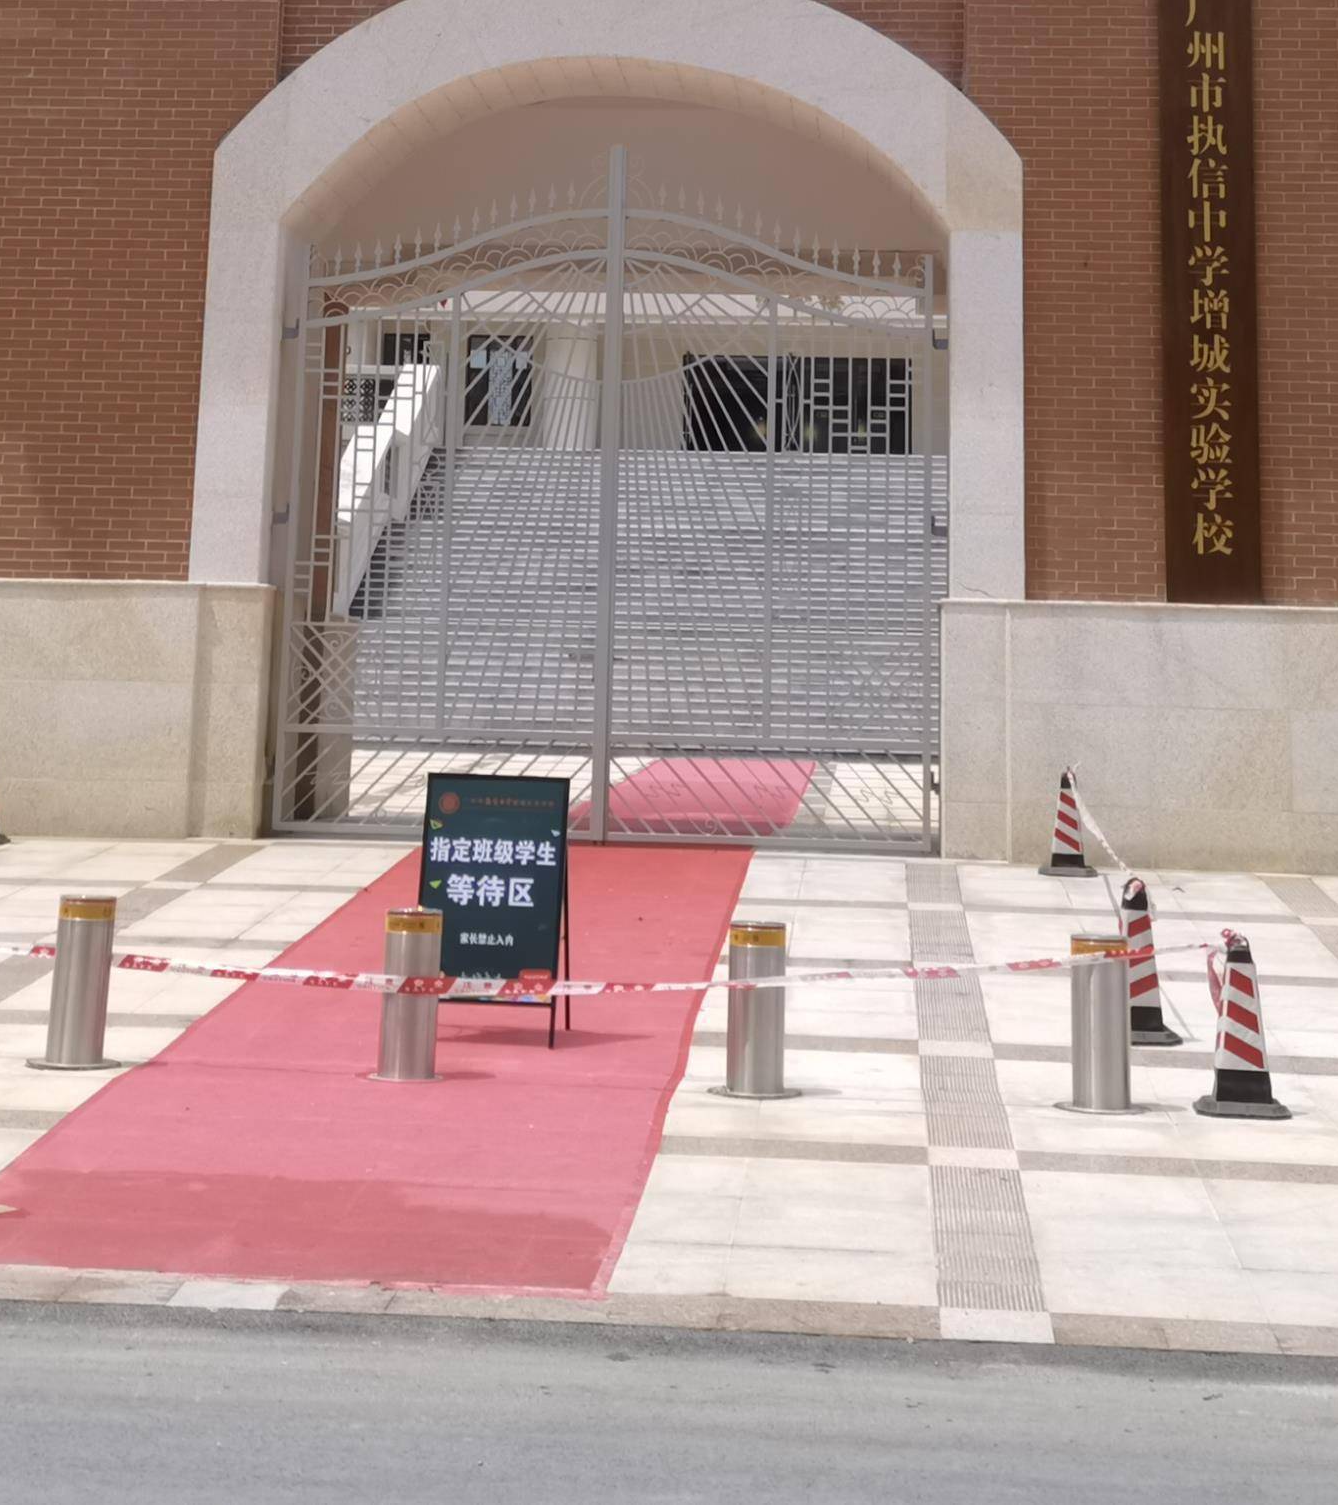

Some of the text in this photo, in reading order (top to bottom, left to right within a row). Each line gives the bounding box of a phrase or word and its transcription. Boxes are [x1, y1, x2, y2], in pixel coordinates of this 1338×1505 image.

[430, 837, 557, 867] 指定班级学生
[446, 874, 535, 908] 等待区
[460, 932, 514, 947] 家长禁止入内
